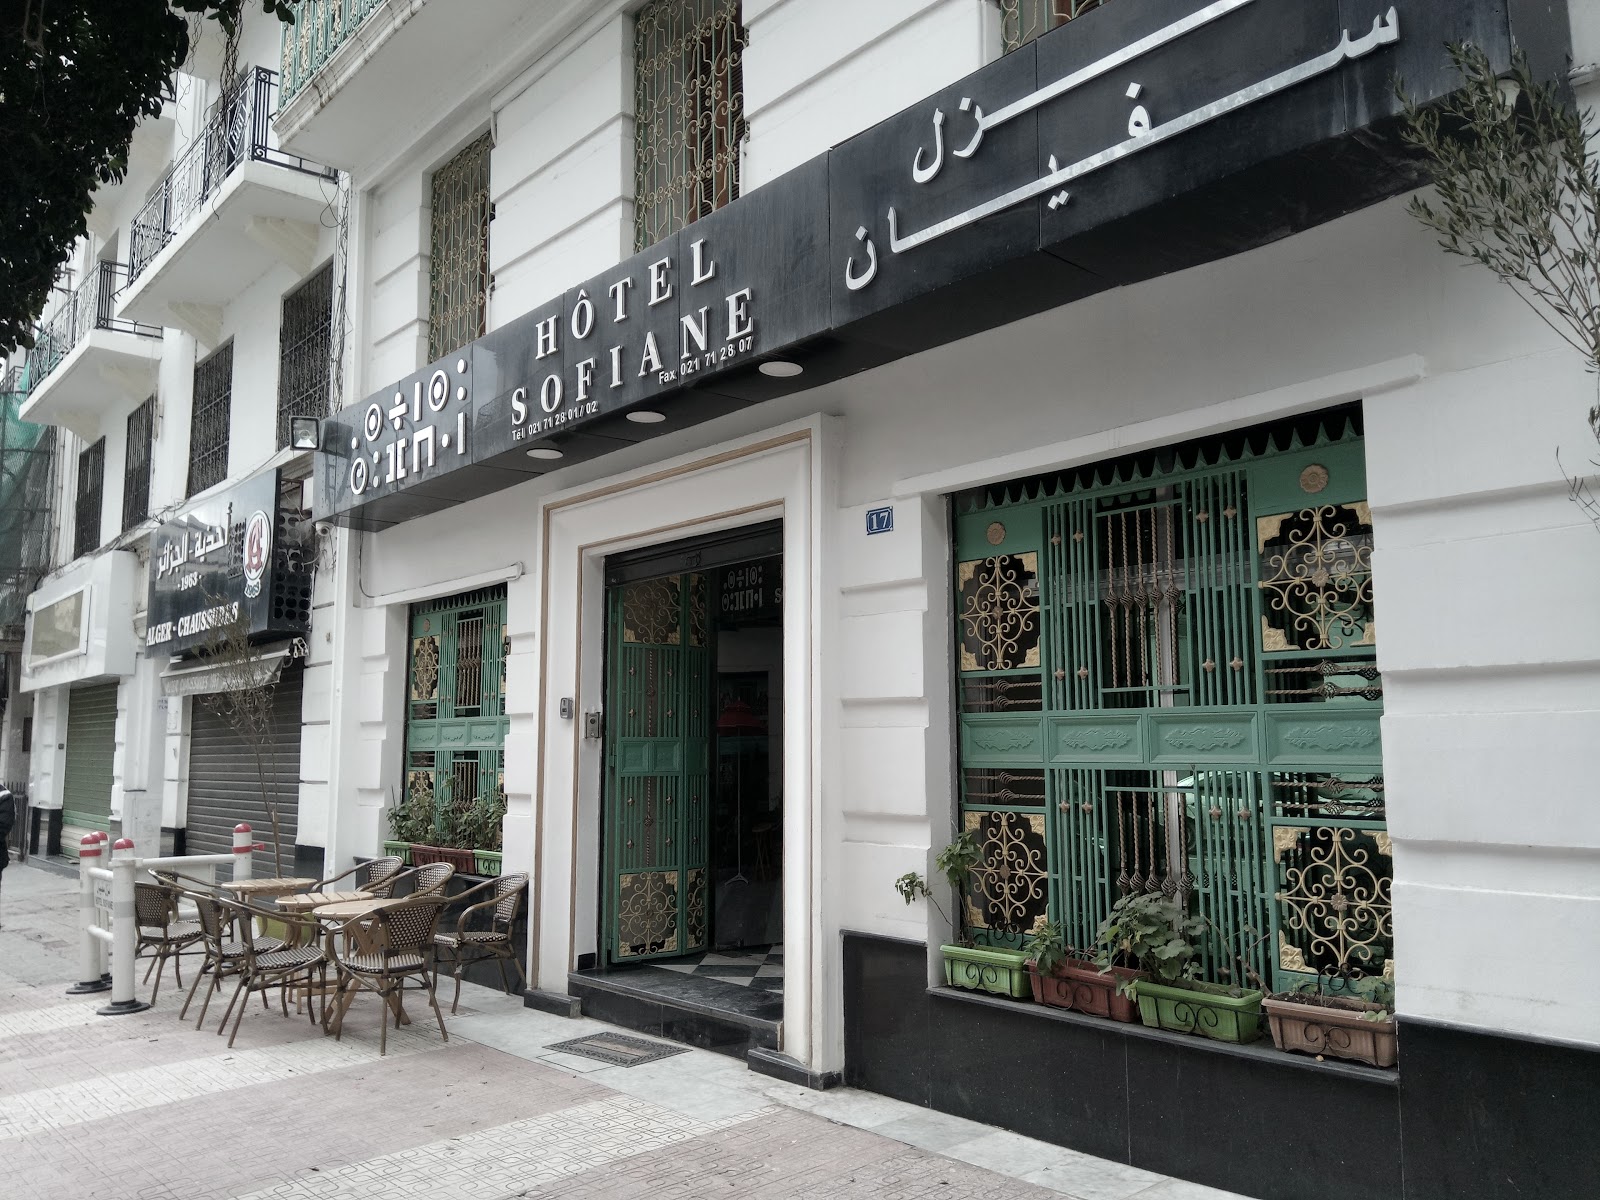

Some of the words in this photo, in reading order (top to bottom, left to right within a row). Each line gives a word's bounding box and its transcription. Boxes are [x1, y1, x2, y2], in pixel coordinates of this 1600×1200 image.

[912, 0, 1254, 184] زل
[845, 5, 1400, 291] سفيان
[535, 238, 716, 360] HÔTEL
[511, 287, 753, 426] SOFIANE
[659, 369, 676, 385] Fax
[681, 358, 700, 375] 021
[705, 351, 717, 366] 71
[720, 344, 735, 360] 28
[739, 336, 753, 352] 07
[512, 428, 525, 441] Tél
[528, 421, 541, 435] 021
[544, 417, 553, 430] 71
[555, 413, 566, 426] 28
[870, 512, 890, 531] 17
[146, 621, 172, 646] ALGER
